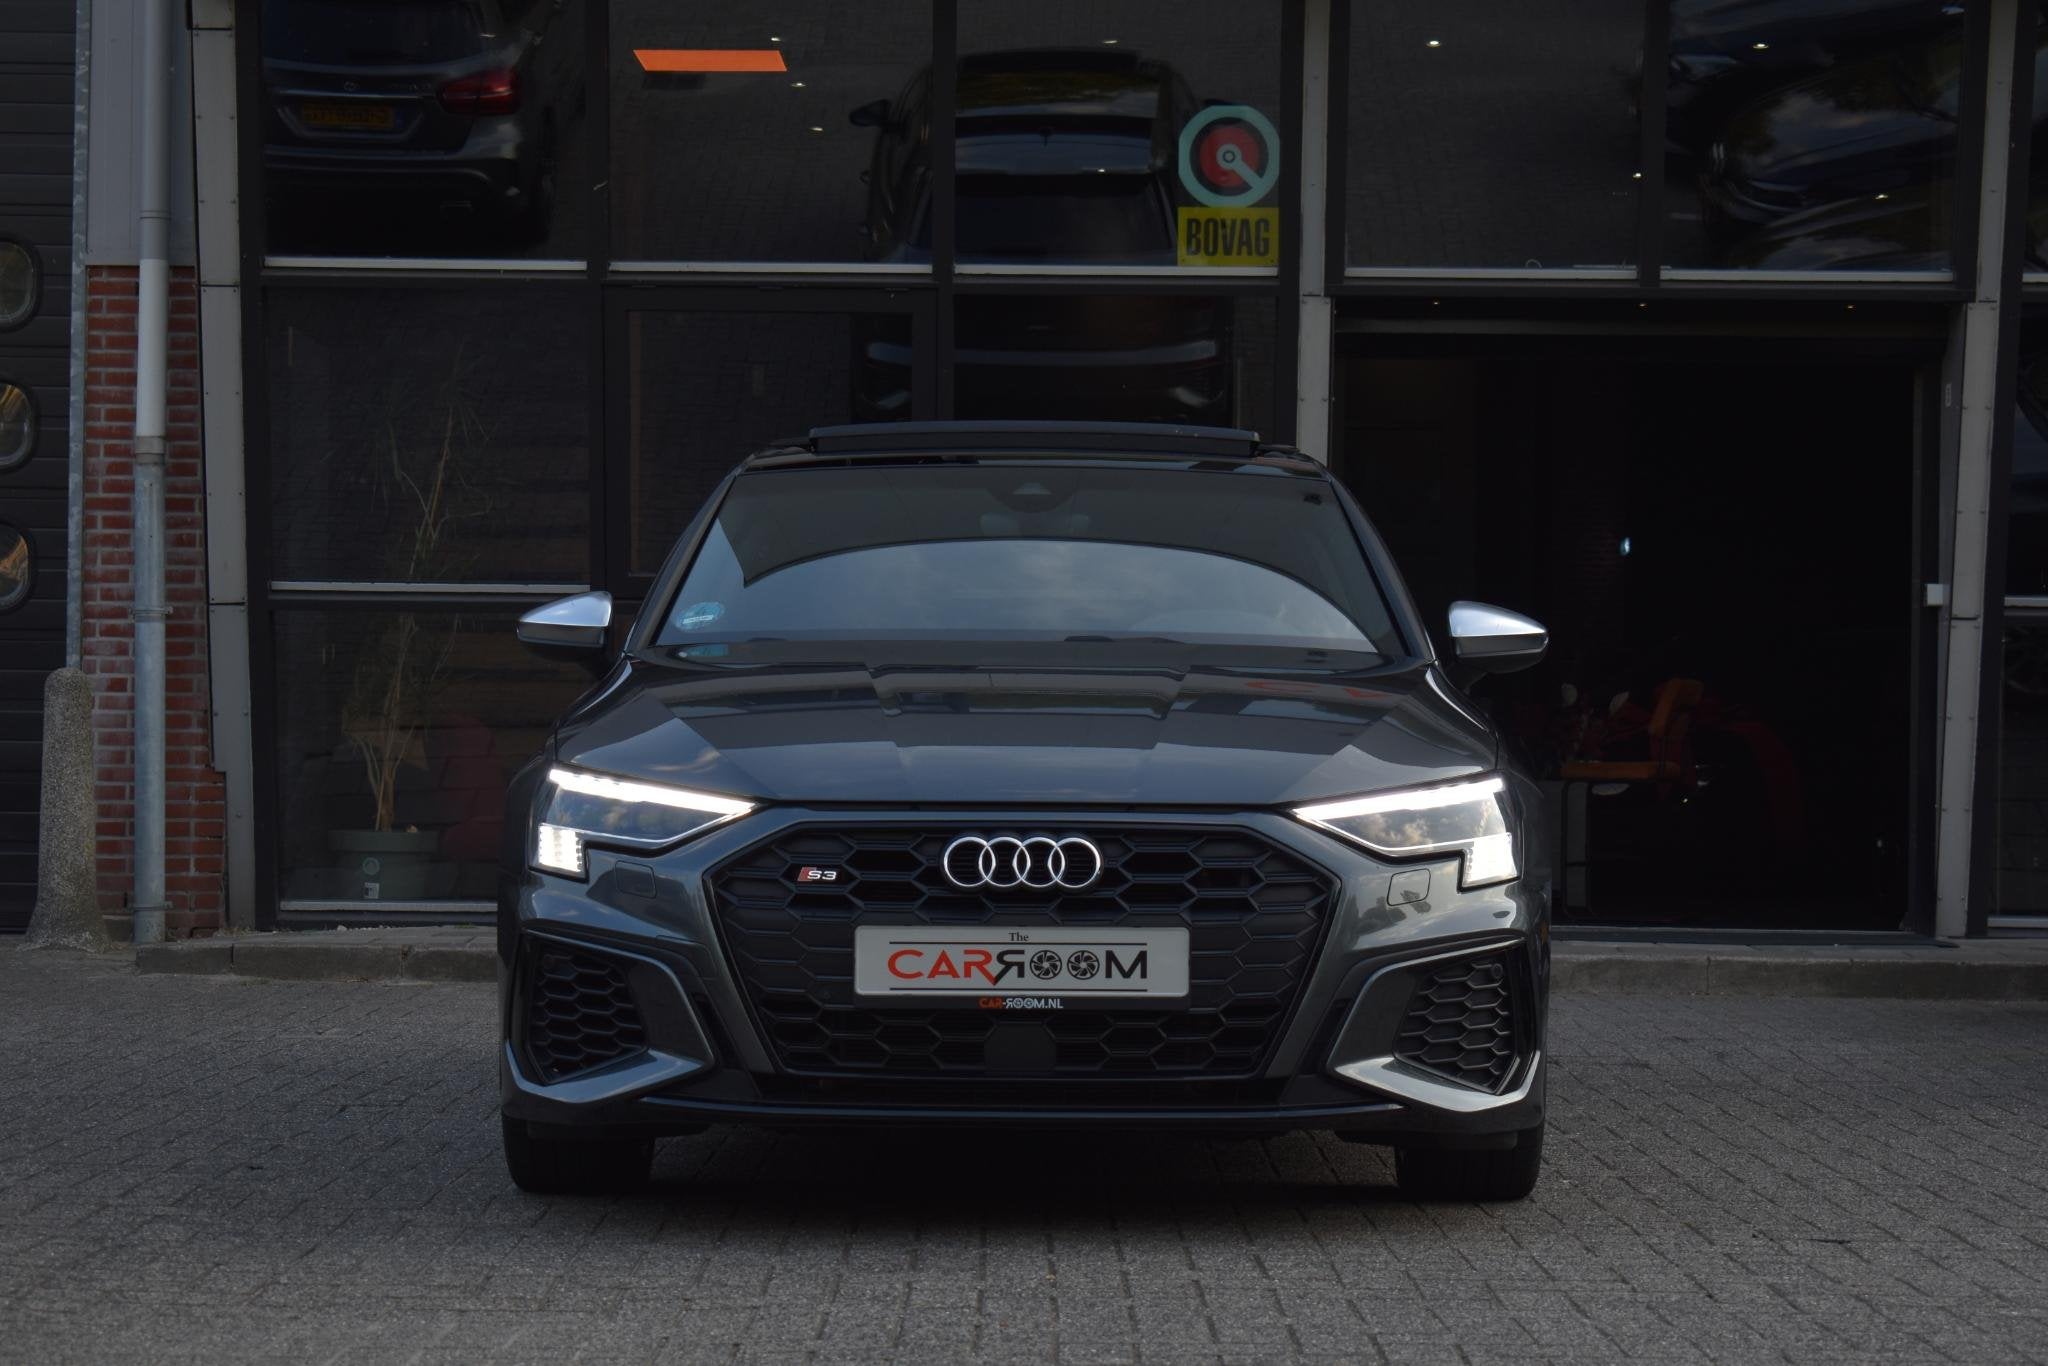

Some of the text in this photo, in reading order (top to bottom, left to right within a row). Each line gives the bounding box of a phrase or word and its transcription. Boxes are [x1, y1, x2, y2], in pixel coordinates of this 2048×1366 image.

[1187, 218, 1270, 257] BOVAG
[807, 870, 837, 880] S3
[1009, 932, 1029, 942] The
